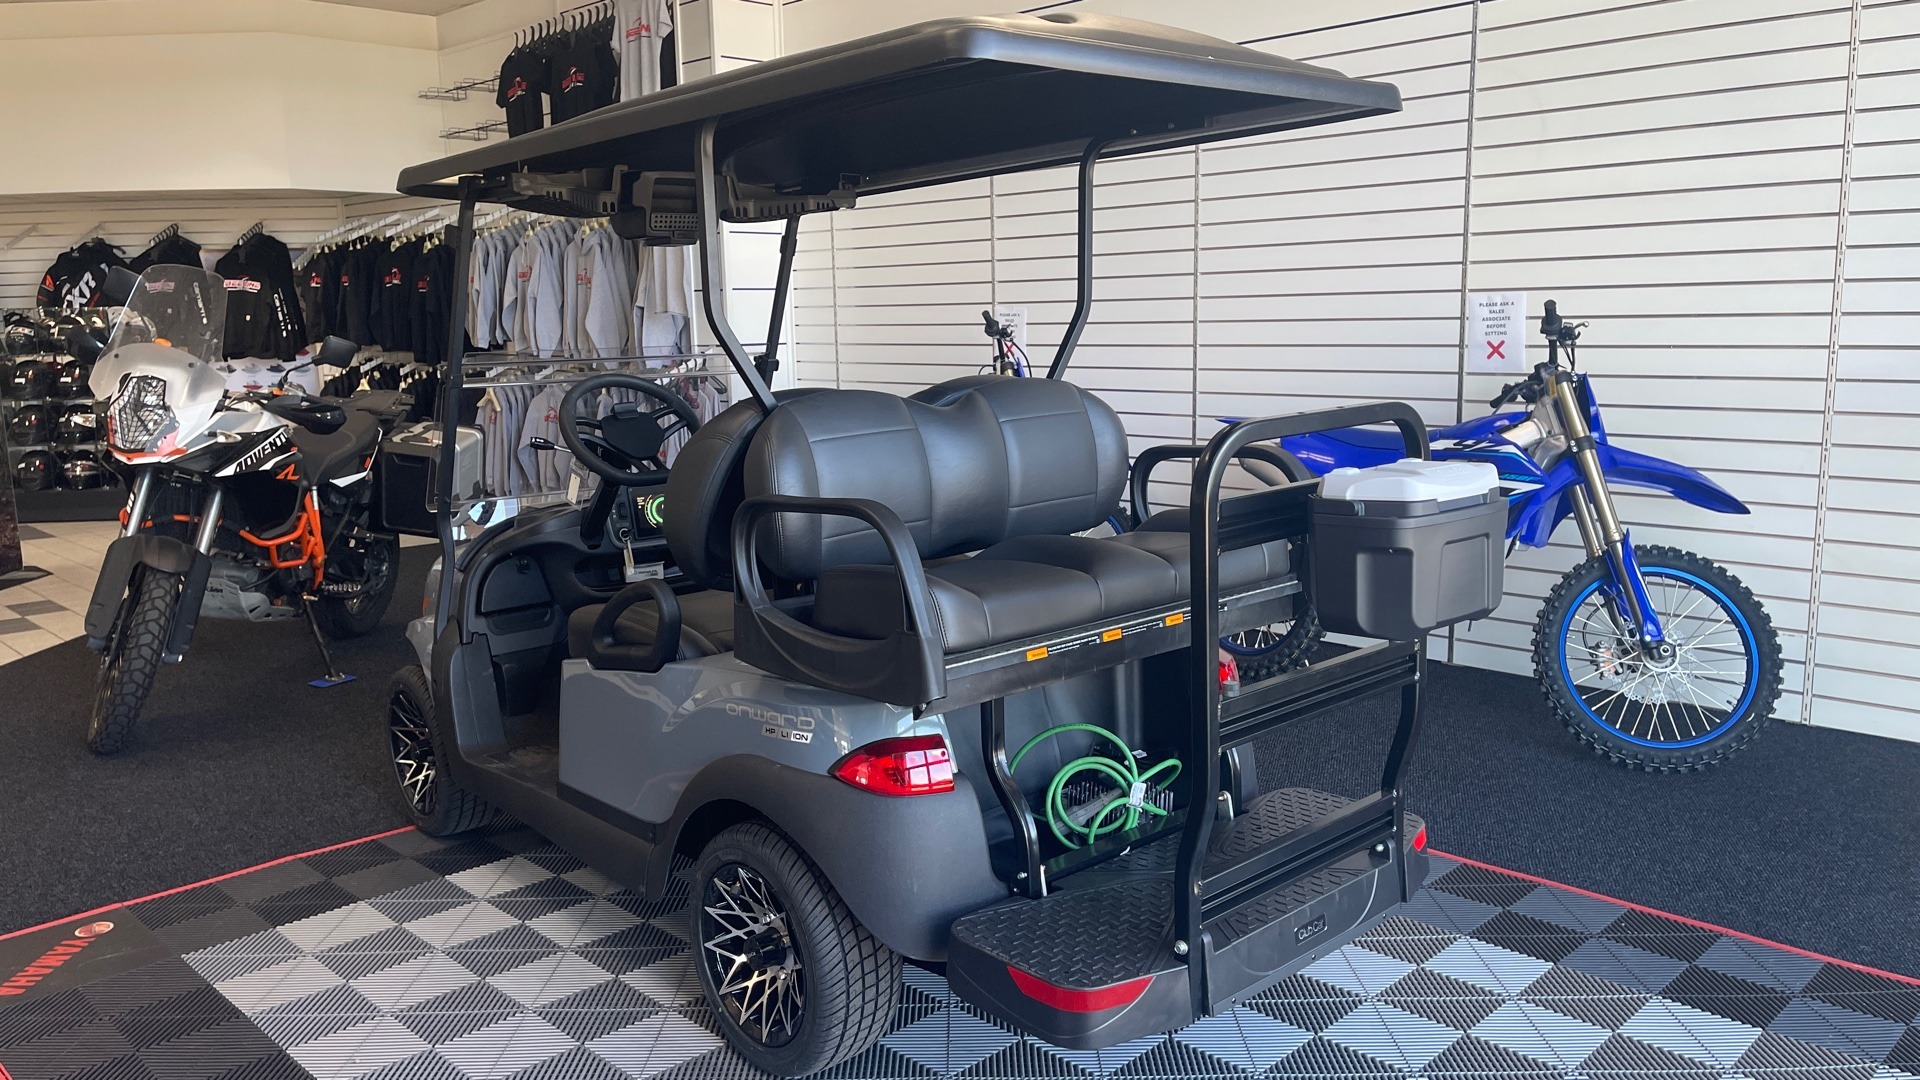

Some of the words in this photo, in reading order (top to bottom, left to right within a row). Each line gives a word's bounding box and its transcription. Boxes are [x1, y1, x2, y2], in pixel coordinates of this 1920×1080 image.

[765, 726, 776, 735] HP
[793, 733, 809, 742] ION
[1298, 925, 1312, 940] Club
